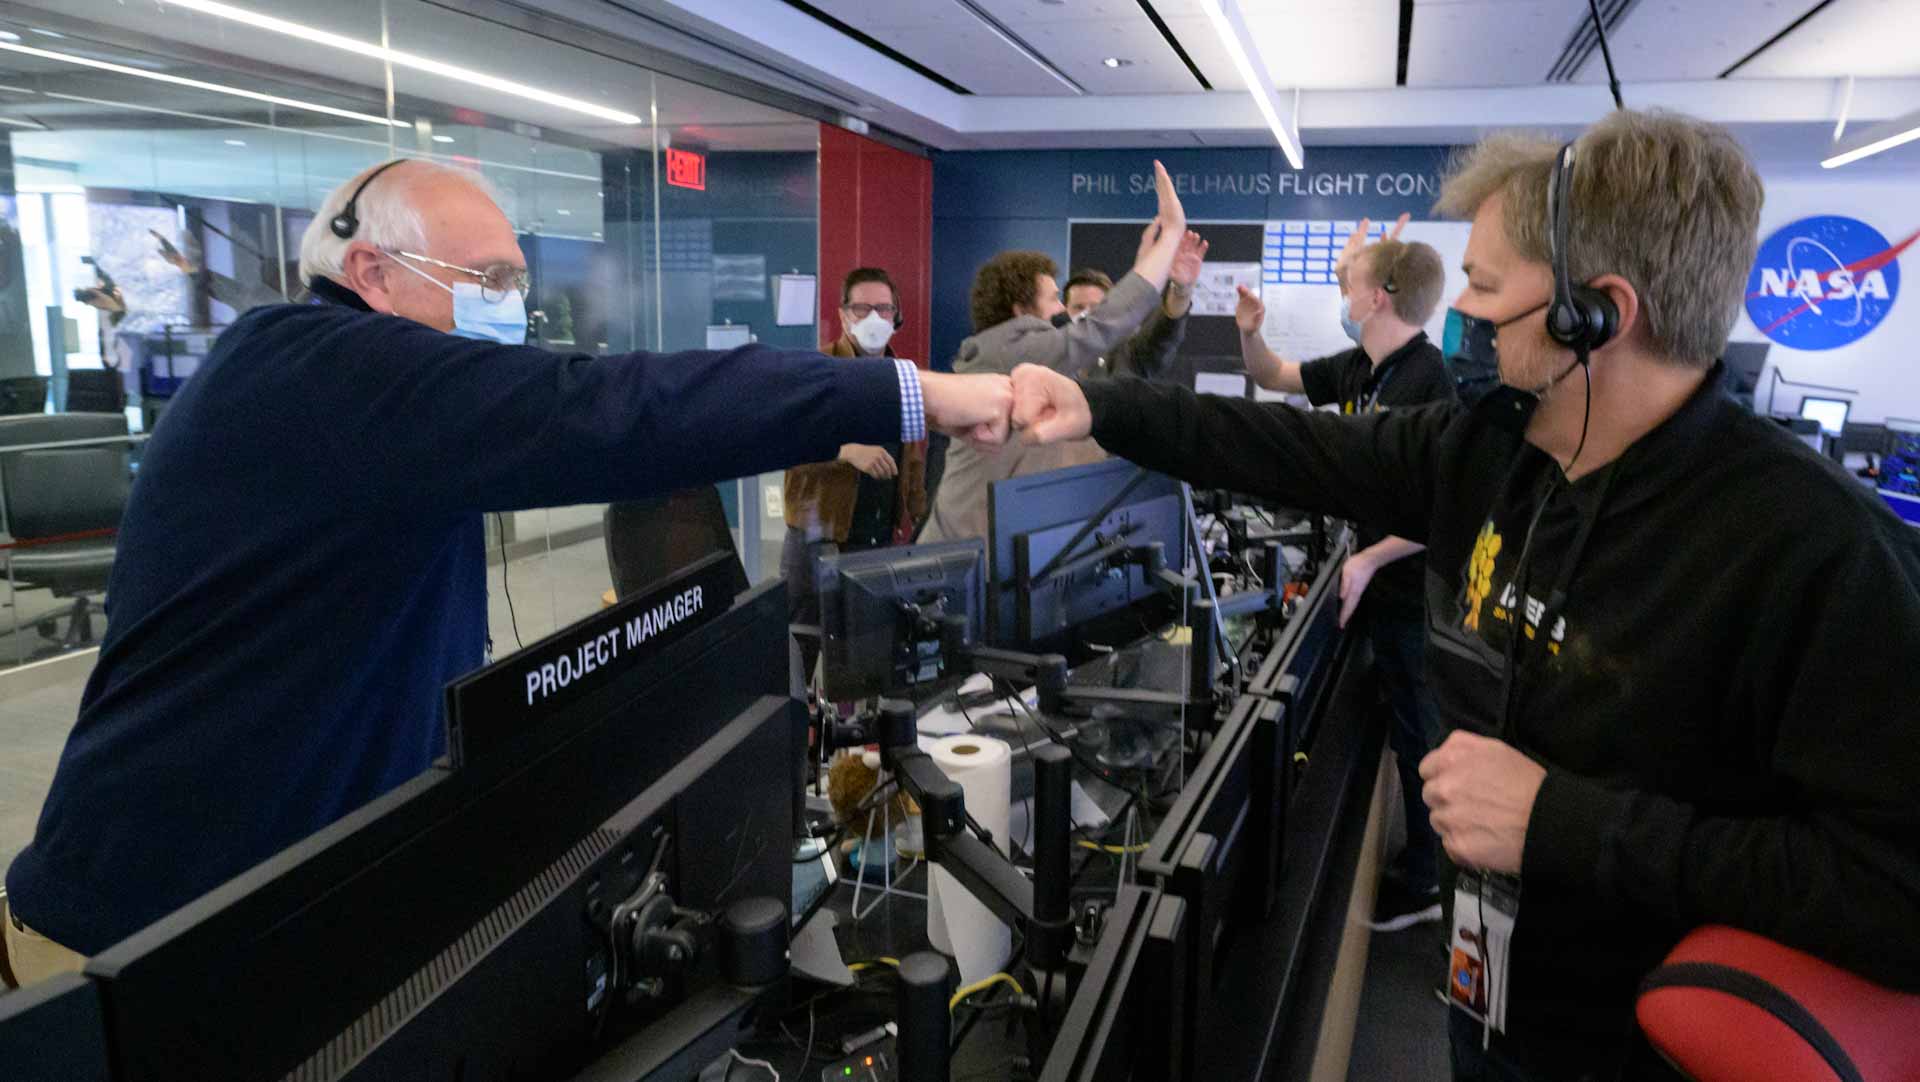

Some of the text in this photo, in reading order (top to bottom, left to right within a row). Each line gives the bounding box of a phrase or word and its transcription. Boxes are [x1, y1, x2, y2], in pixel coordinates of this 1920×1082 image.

[1072, 173, 1435, 196] PHIL SAELHAUS FLIGHT CON
[1759, 267, 1890, 300] NASA
[525, 585, 703, 706] PROJECT MANAGER
